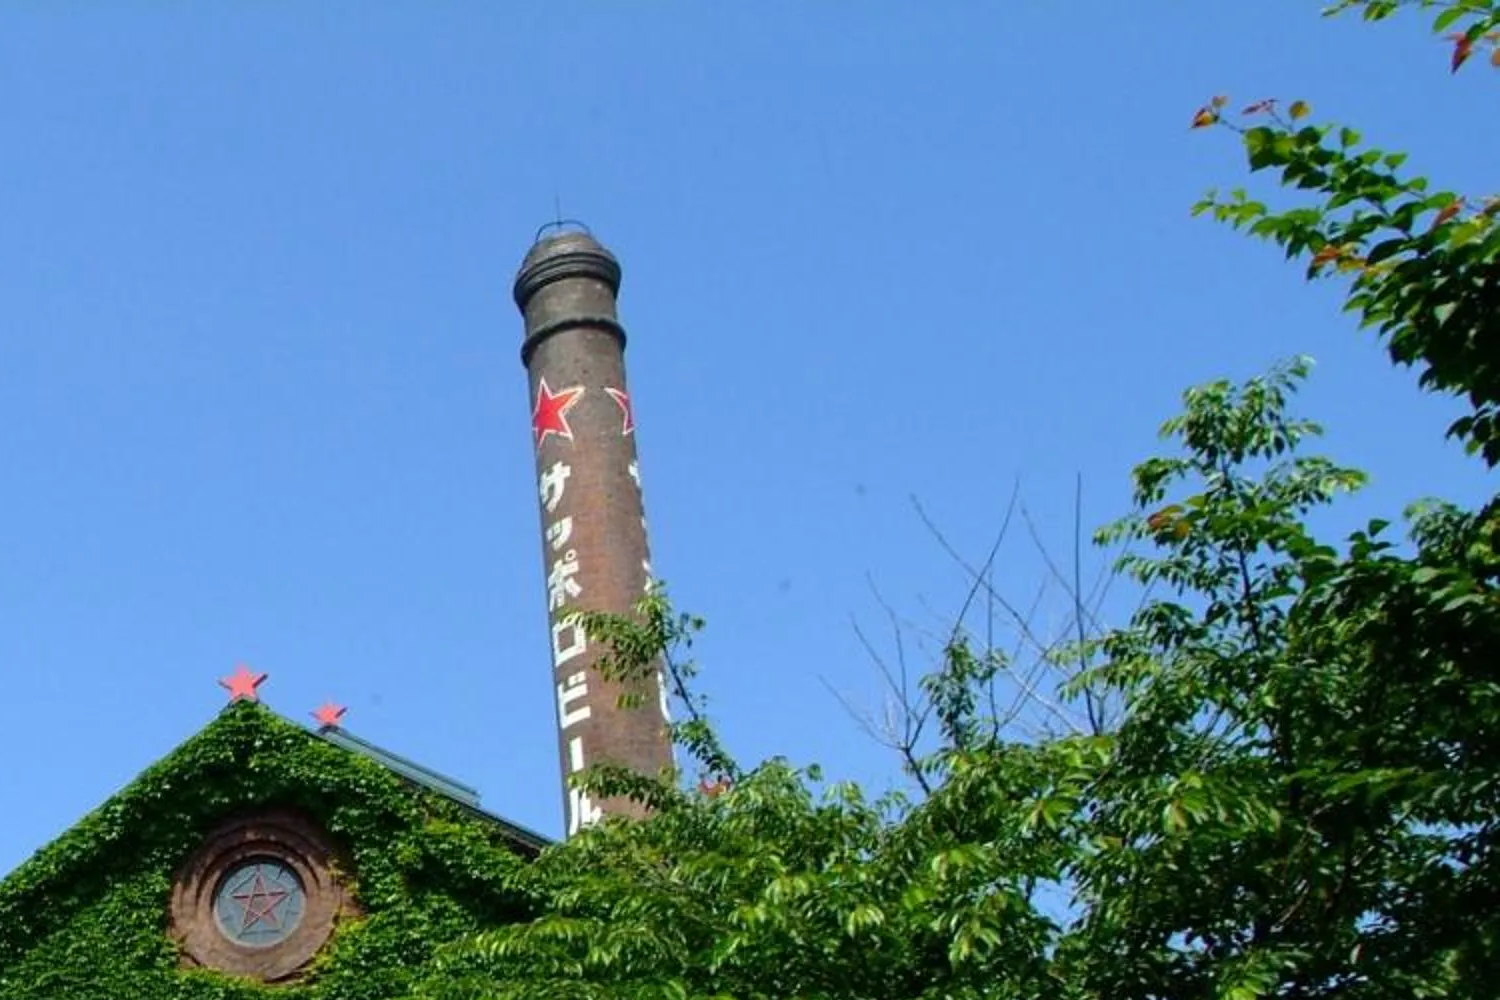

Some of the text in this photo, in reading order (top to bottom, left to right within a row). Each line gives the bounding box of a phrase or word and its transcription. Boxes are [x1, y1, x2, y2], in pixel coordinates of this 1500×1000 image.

[539, 460, 601, 837] サッポロビール
